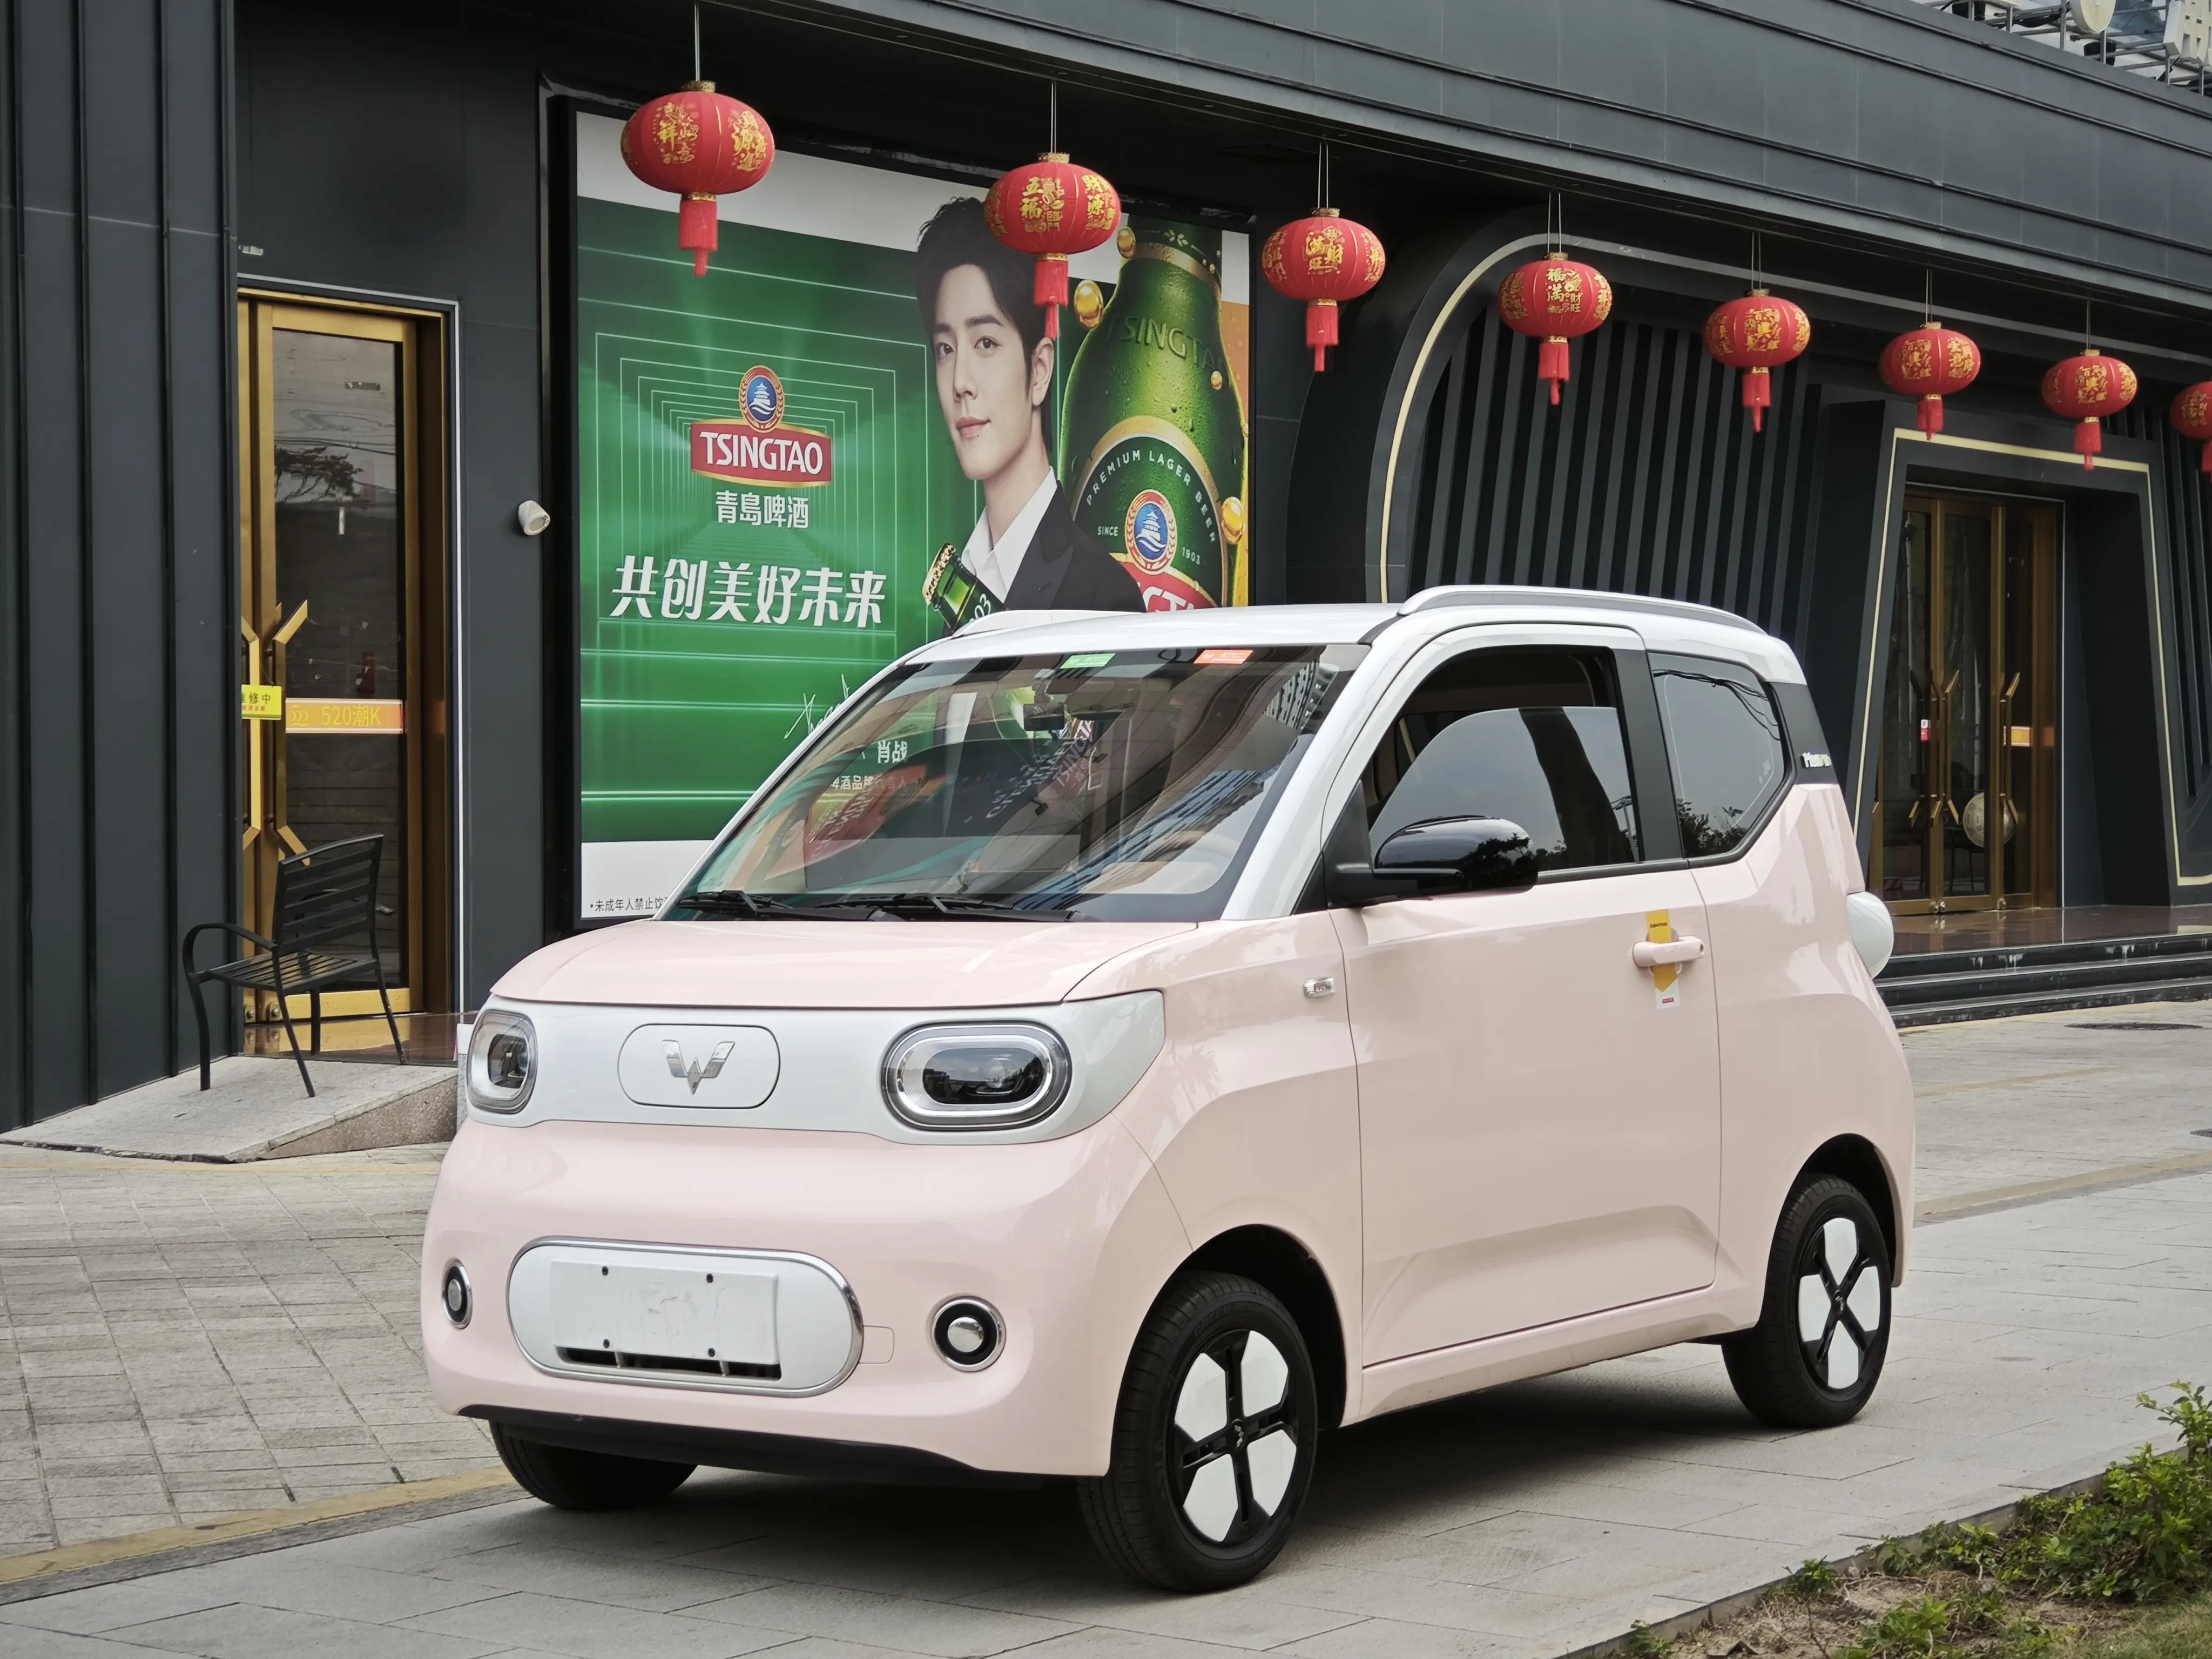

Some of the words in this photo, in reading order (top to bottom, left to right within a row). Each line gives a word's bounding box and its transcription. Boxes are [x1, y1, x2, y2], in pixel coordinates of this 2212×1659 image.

[700, 431, 823, 475] TSINGTAO
[715, 490, 809, 529] 青島啤酒
[1086, 449, 1141, 505] PREMIUM
[1149, 450, 1191, 487] LAGER
[1195, 490, 1216, 543] BEER
[1097, 525, 1119, 537] SINCE
[1182, 546, 1201, 565] 1903
[609, 554, 887, 628] 共创美好未来
[877, 739, 908, 764] 肖战
